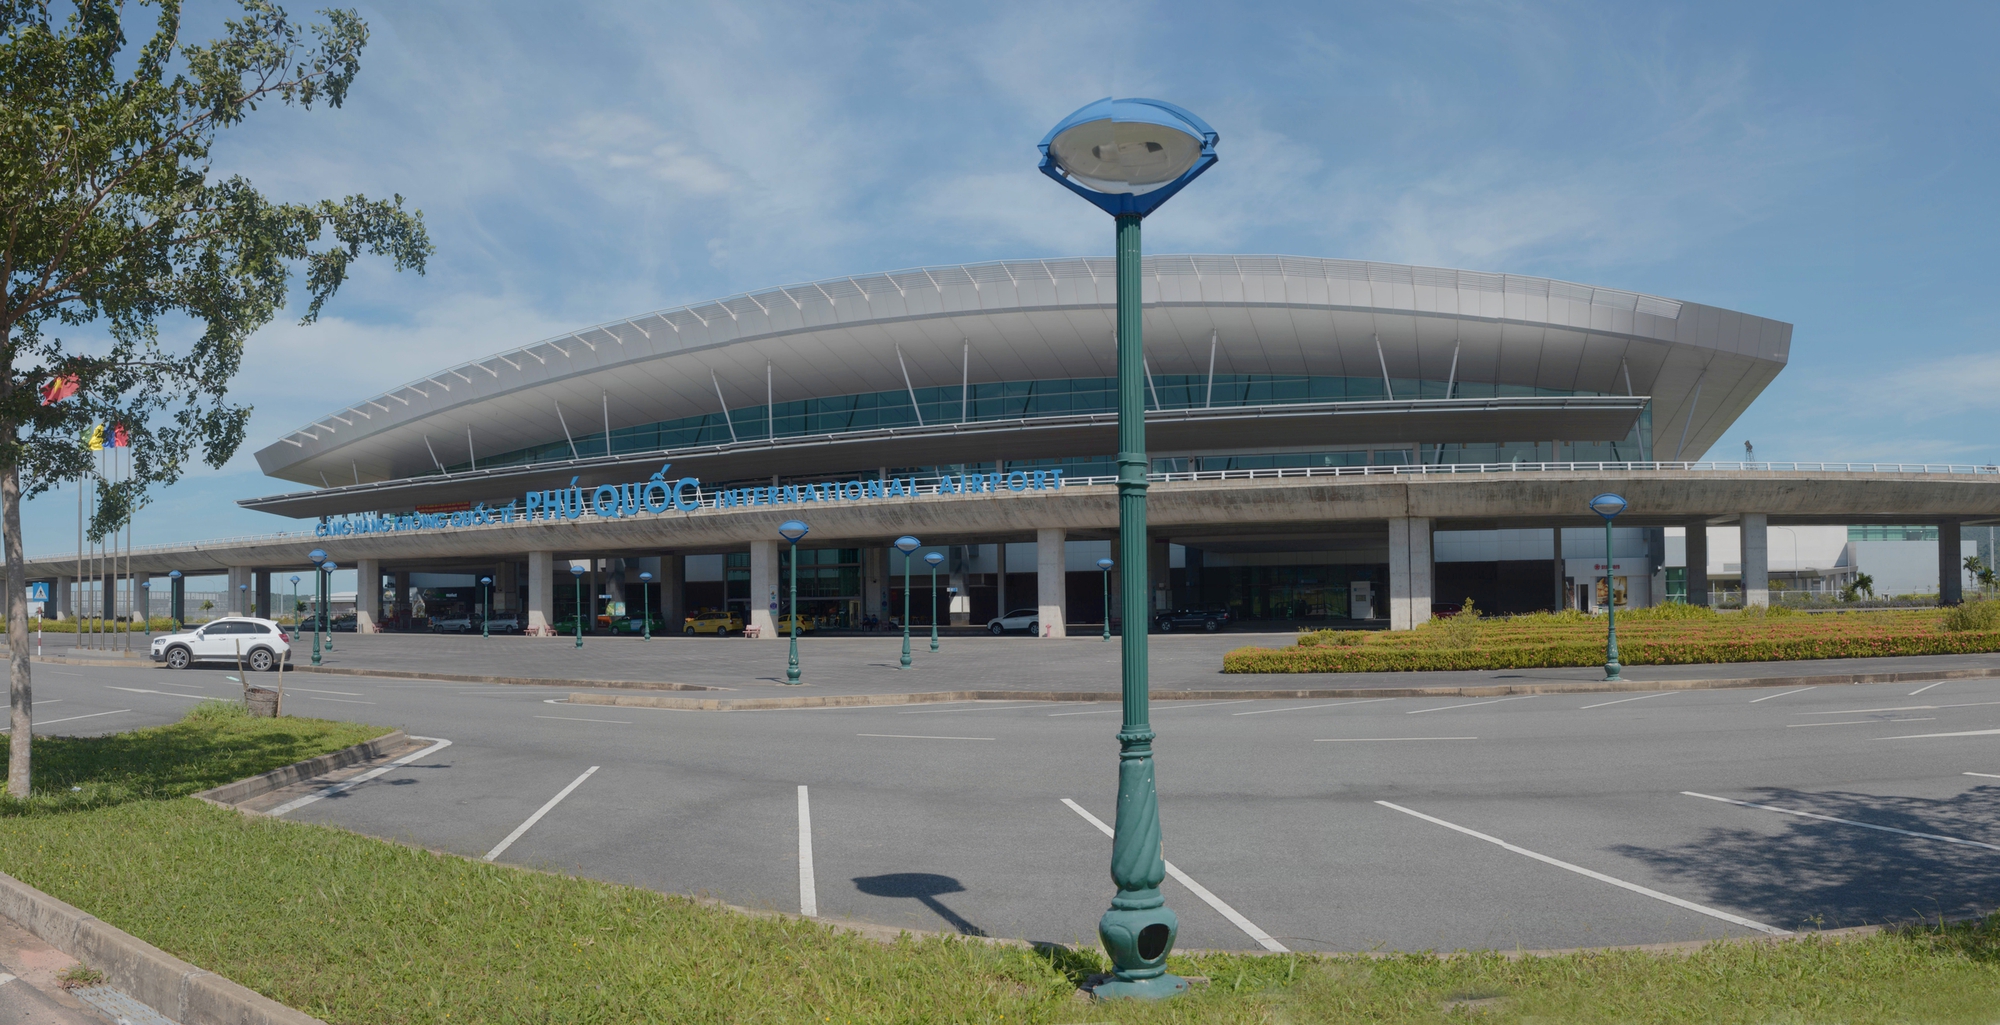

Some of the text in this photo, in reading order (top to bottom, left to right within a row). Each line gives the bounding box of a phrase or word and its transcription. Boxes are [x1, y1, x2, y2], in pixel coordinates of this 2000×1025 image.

[315, 516, 352, 537] CẢNG
[353, 513, 391, 534] HÀNG
[393, 511, 448, 532] KHÔNG
[450, 501, 497, 527] QUỐC
[500, 498, 518, 524] TẾ
[526, 475, 582, 522] PHÚ
[593, 463, 701, 518] QUỐC
[715, 476, 921, 509] INTERNATIONAL
[938, 468, 1063, 496] AIRPORT
